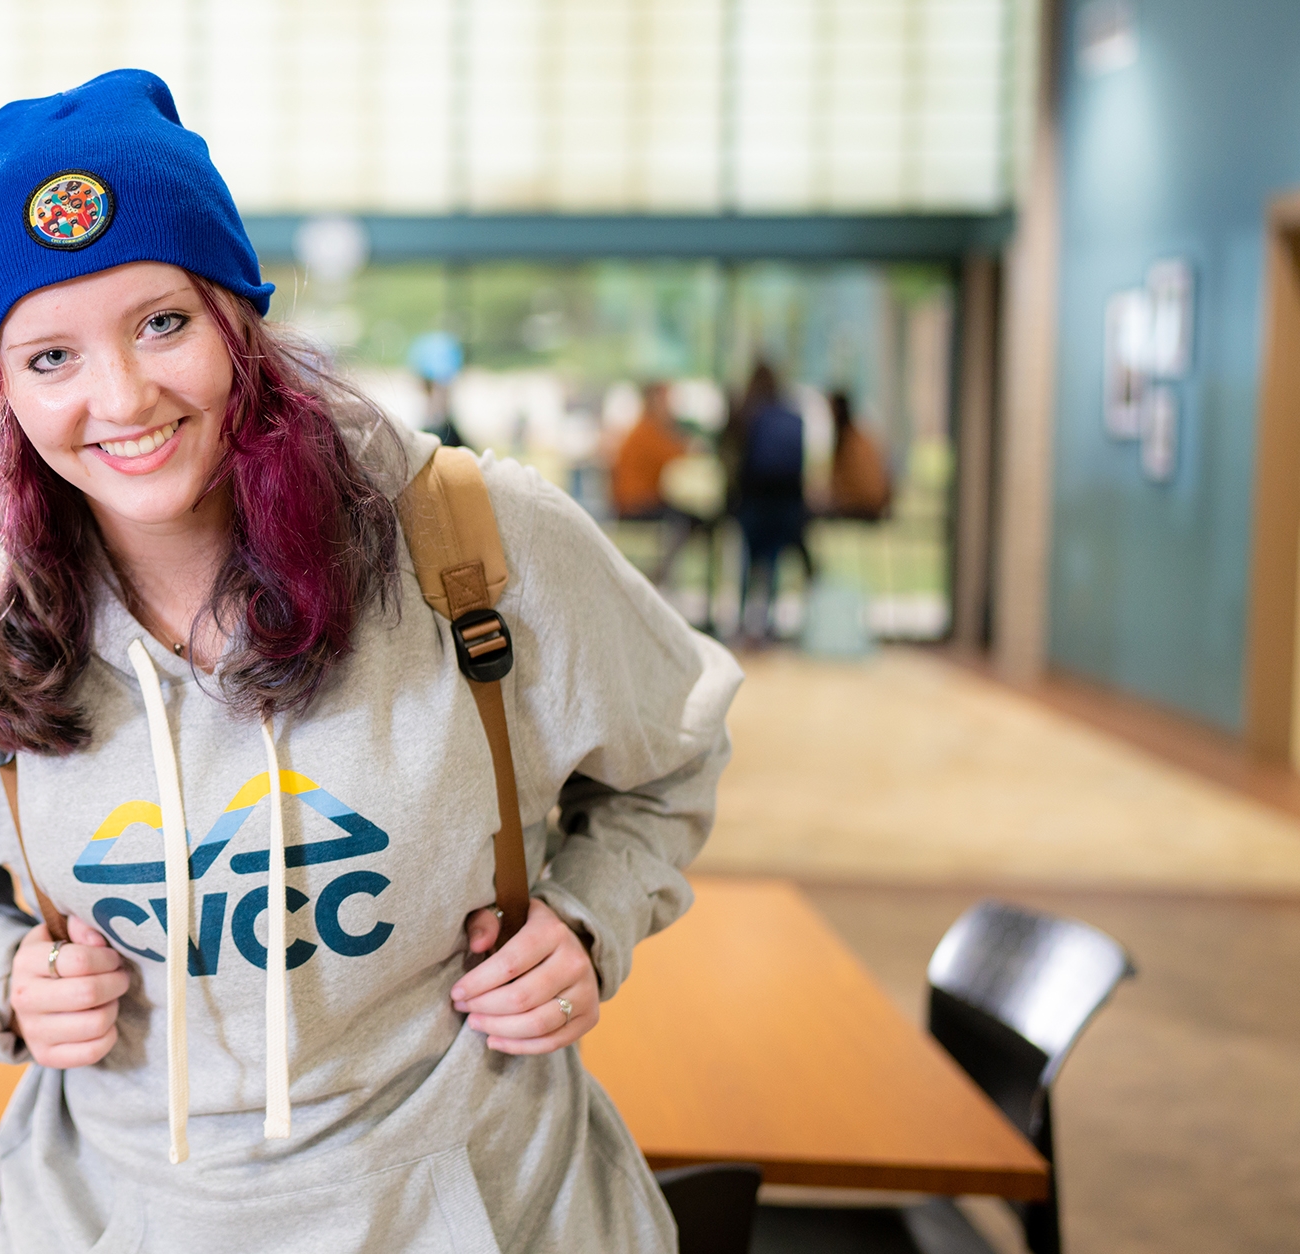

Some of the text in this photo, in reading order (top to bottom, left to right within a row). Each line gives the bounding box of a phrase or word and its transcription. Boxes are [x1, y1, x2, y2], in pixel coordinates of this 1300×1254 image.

[71, 176, 97, 187] ANNIVERSARY
[62, 234, 88, 243] COMMUNITY
[92, 870, 395, 977] CVCC
